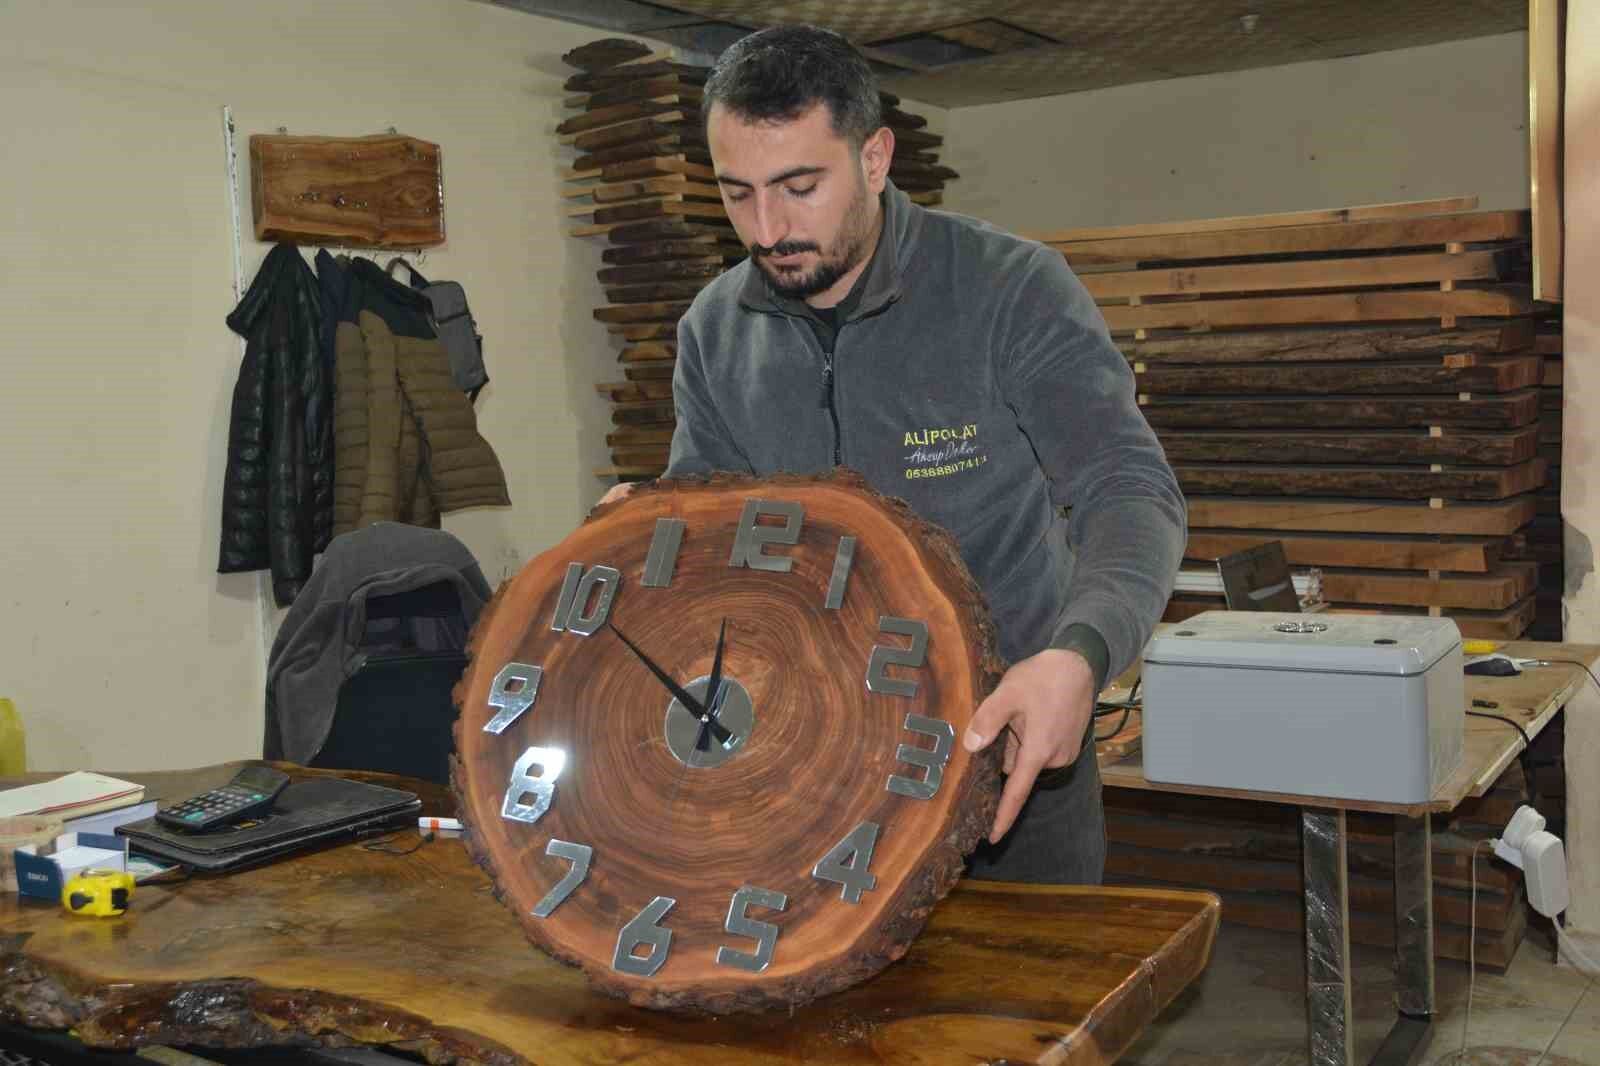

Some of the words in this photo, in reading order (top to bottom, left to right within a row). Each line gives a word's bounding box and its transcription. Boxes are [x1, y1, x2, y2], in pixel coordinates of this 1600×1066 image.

[728, 497, 805, 572] 12
[825, 535, 857, 610] 1
[551, 562, 620, 637] 10
[866, 615, 930, 698] 2
[482, 662, 544, 735] 9
[500, 746, 567, 824] 8
[886, 713, 955, 800] 3
[530, 839, 593, 918] 7
[812, 821, 880, 904] 4
[612, 895, 677, 978] 6
[716, 886, 789, 973] 5
